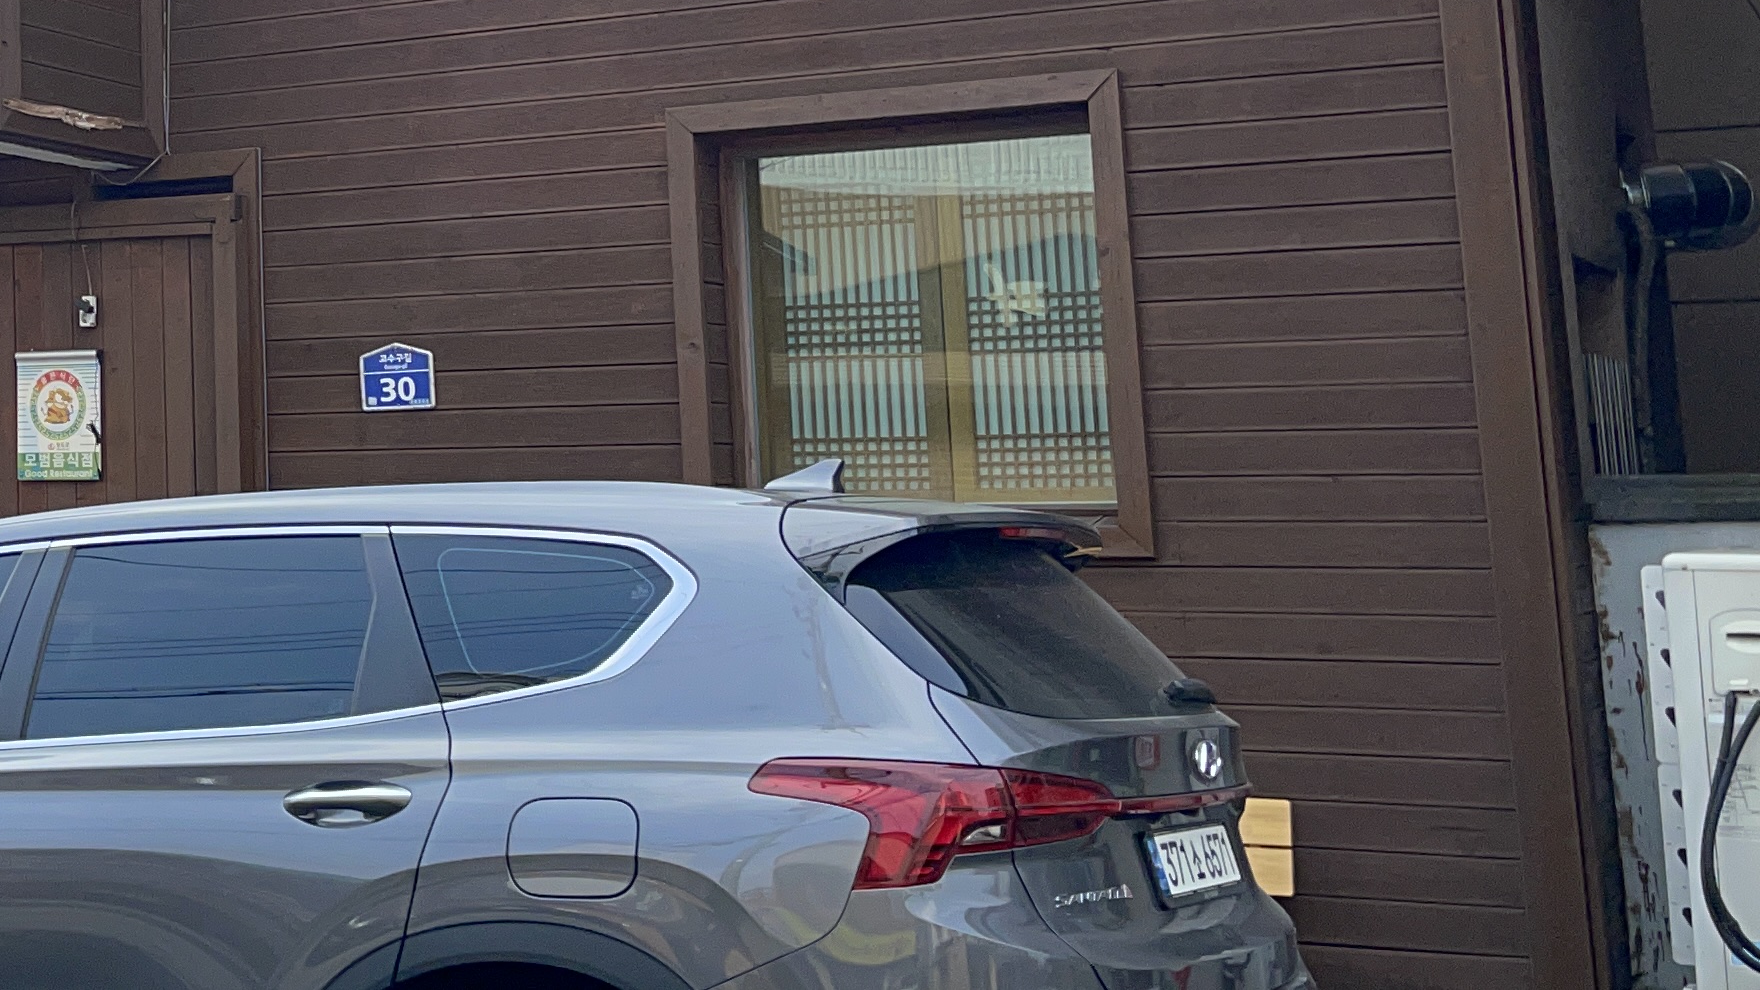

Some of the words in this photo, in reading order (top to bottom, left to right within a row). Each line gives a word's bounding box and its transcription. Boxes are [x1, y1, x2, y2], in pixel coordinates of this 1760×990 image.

[380, 376, 416, 402] 30
[24, 453, 94, 469] 모범음식점
[25, 469, 48, 478] Good
[49, 469, 93, 478] Restaurant
